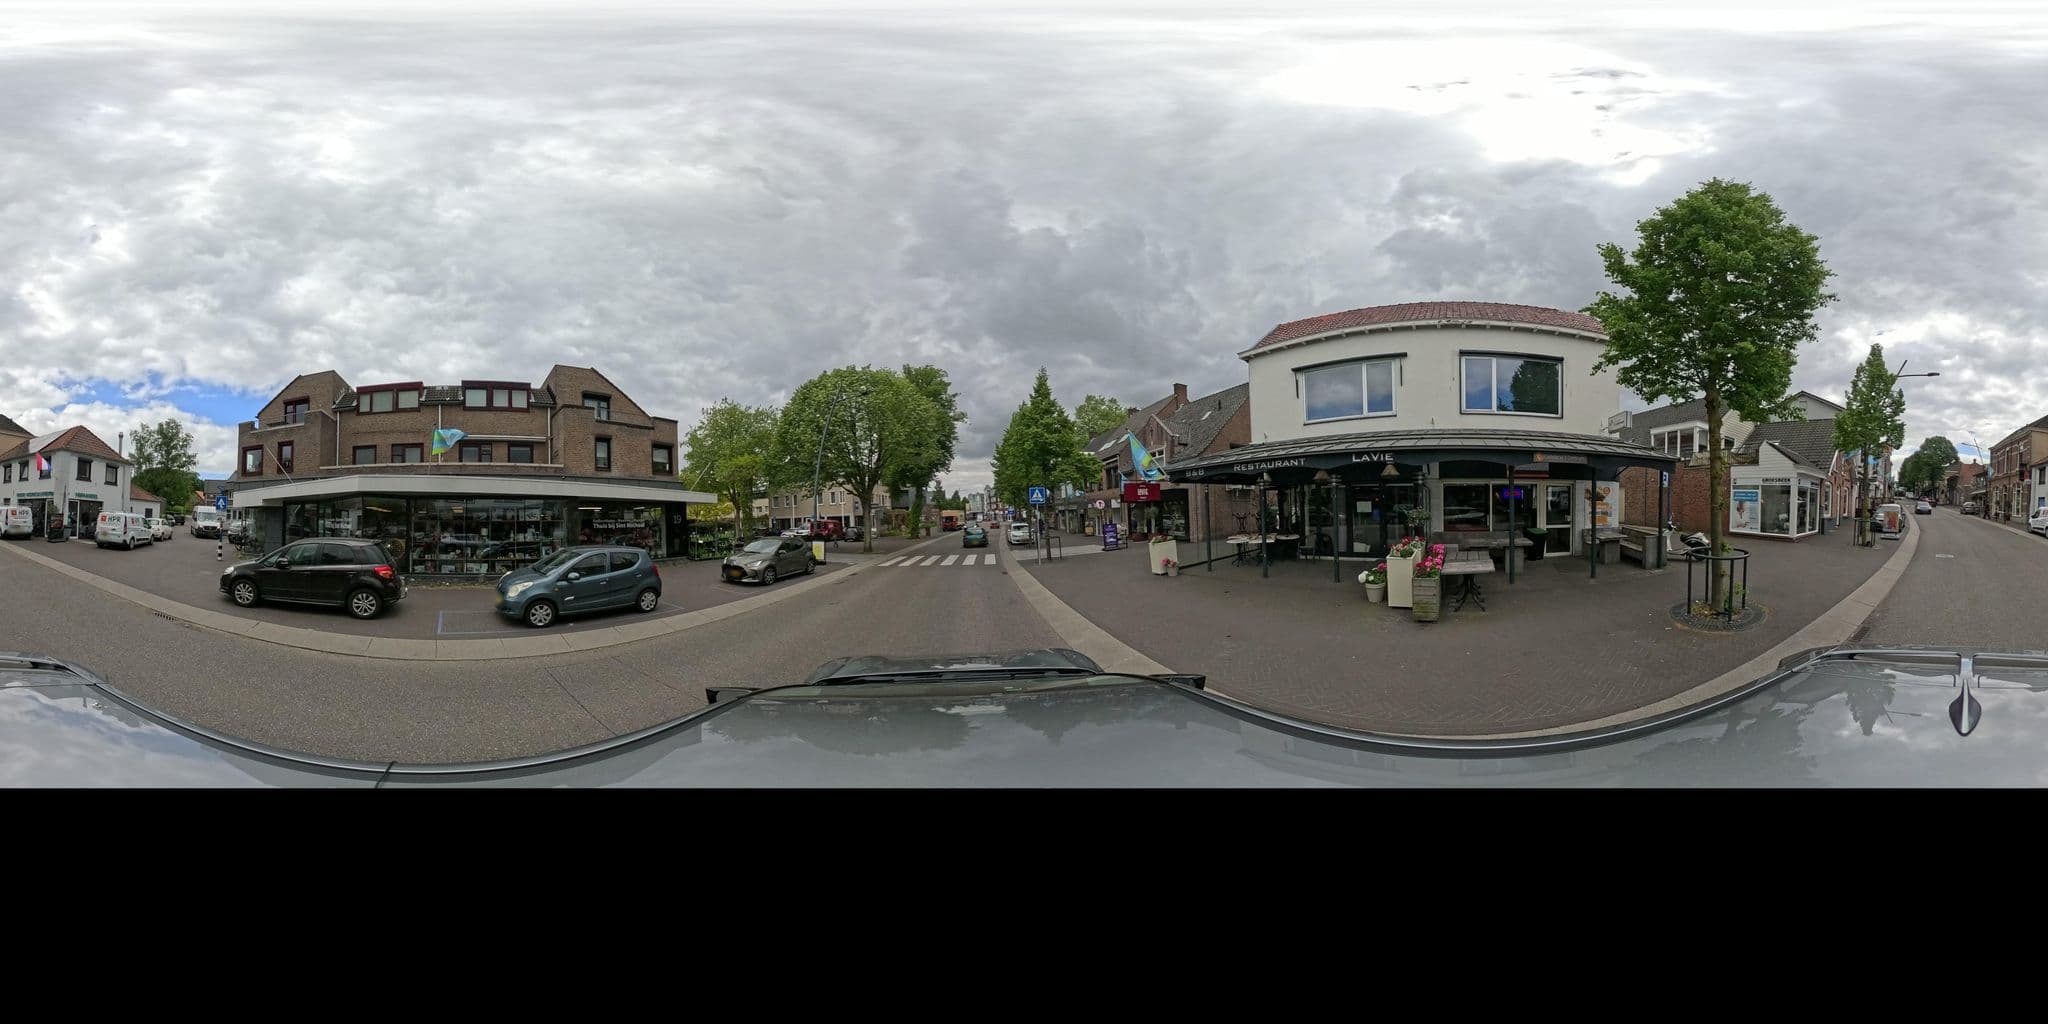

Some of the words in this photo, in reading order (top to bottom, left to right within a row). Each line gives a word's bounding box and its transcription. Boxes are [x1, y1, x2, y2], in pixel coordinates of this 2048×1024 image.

[1234, 458, 1306, 472] RESTAURANT
[1185, 468, 1205, 477] B&B
[107, 515, 121, 523] HPR
[673, 515, 682, 524] 19
